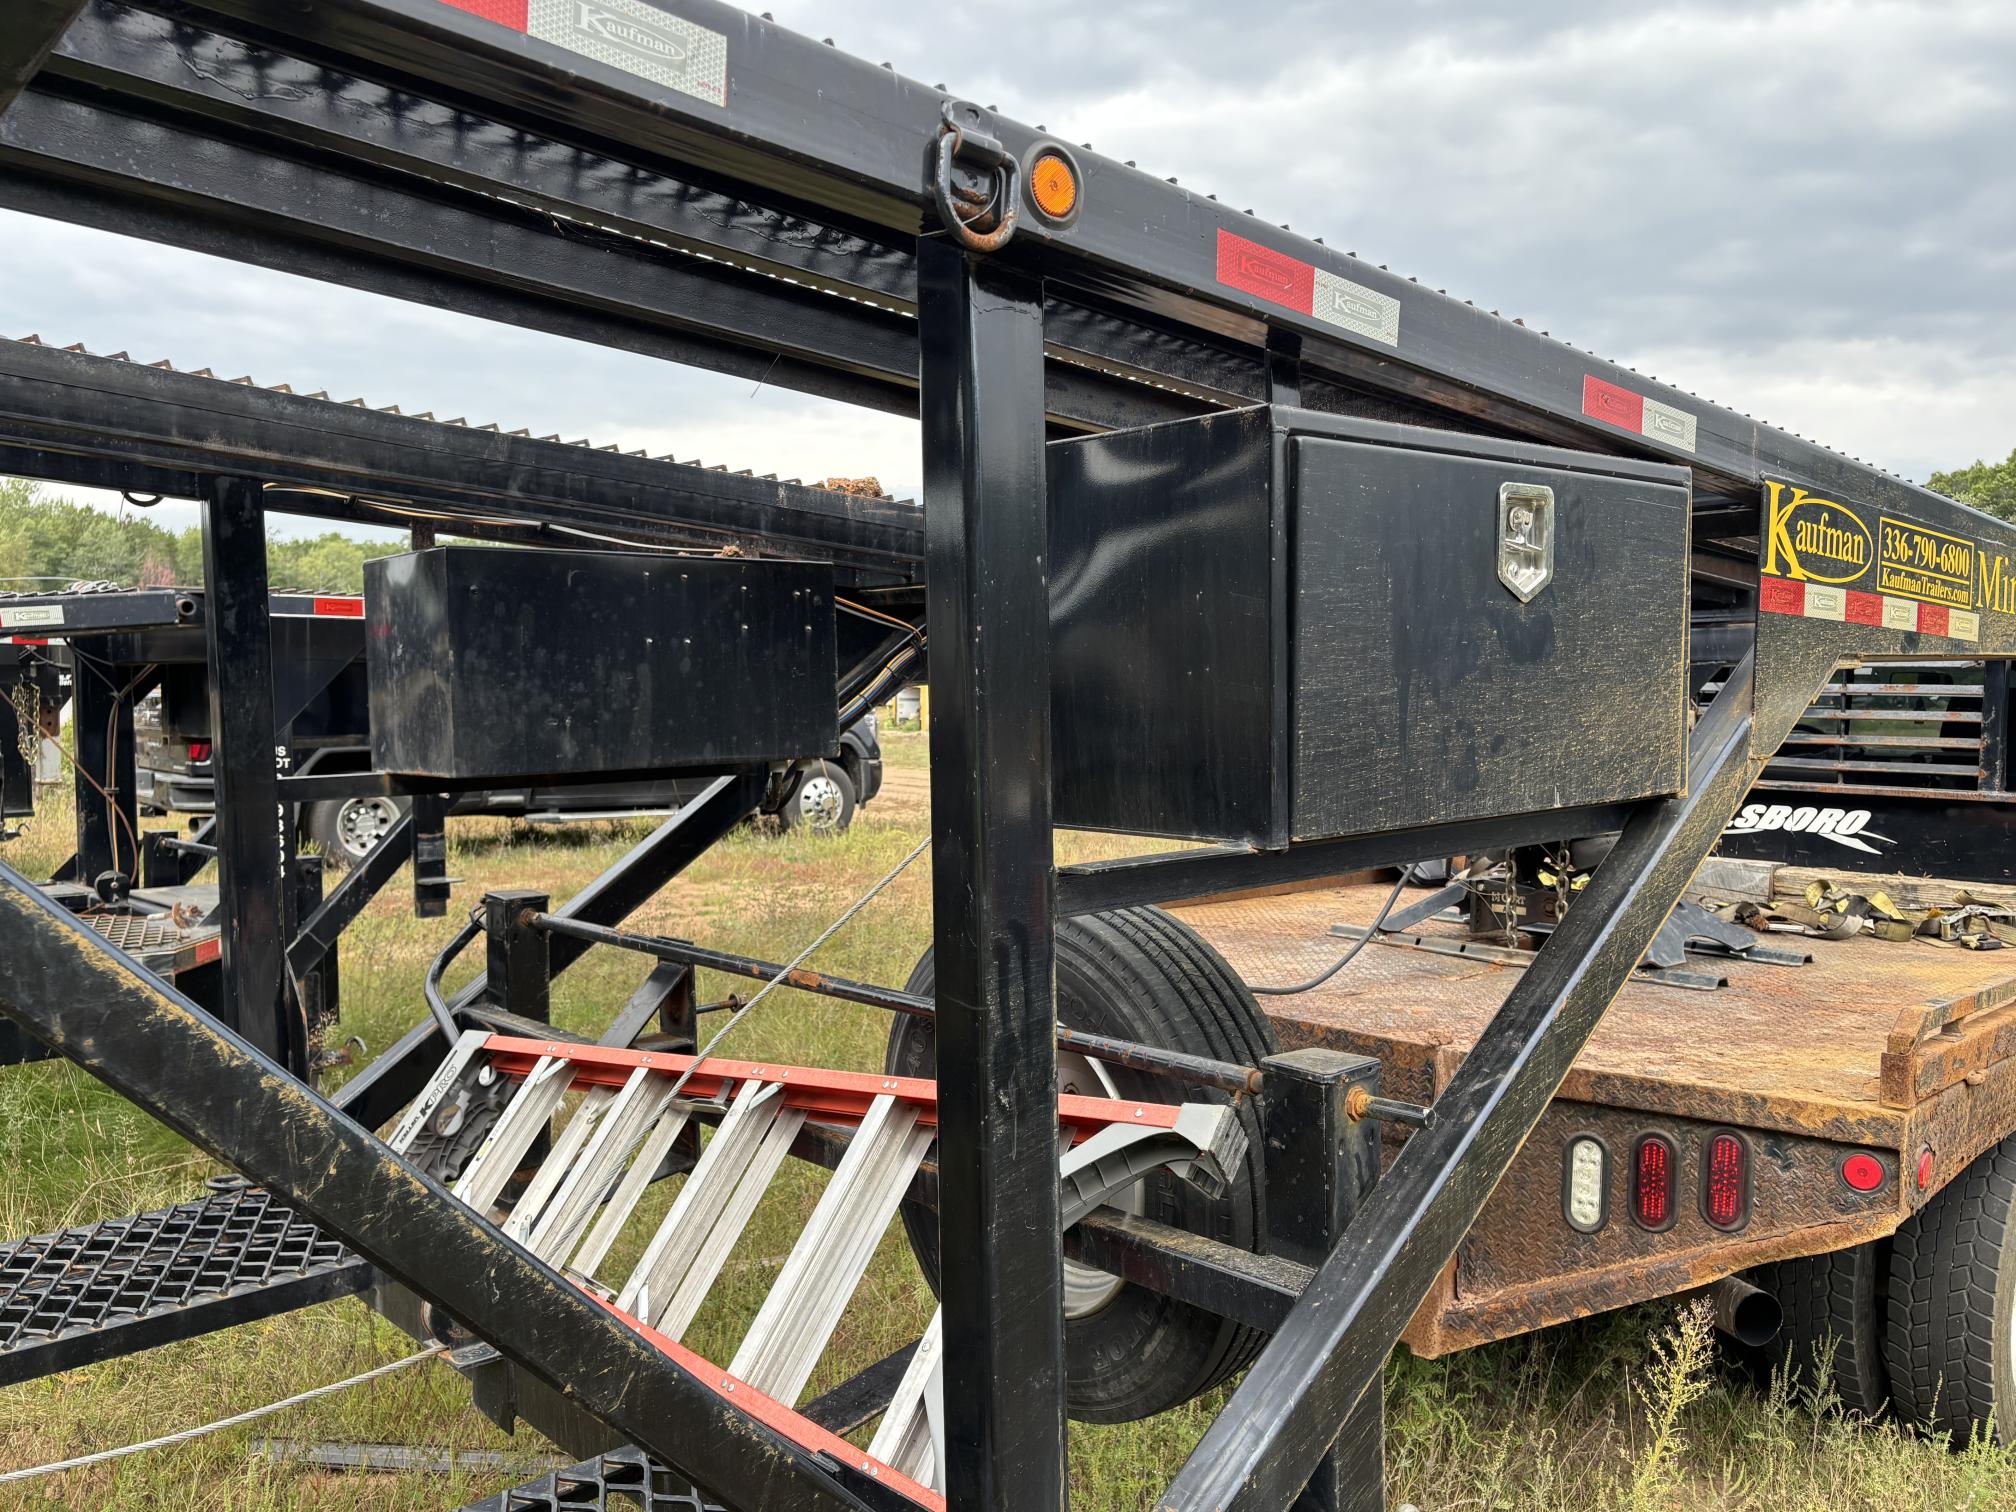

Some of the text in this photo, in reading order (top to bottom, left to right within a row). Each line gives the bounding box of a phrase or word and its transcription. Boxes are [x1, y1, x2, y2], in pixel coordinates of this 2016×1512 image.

[575, 1, 676, 57] Kaufman
[1240, 255, 1289, 286] Kaufman
[1334, 291, 1378, 319] Kaufman
[1761, 480, 1864, 581] Kaufman
[1884, 526, 1970, 578] 336-790-6800
[1881, 567, 1969, 604] KaufmanTrailers.com
[1727, 804, 1872, 835] SBORO
